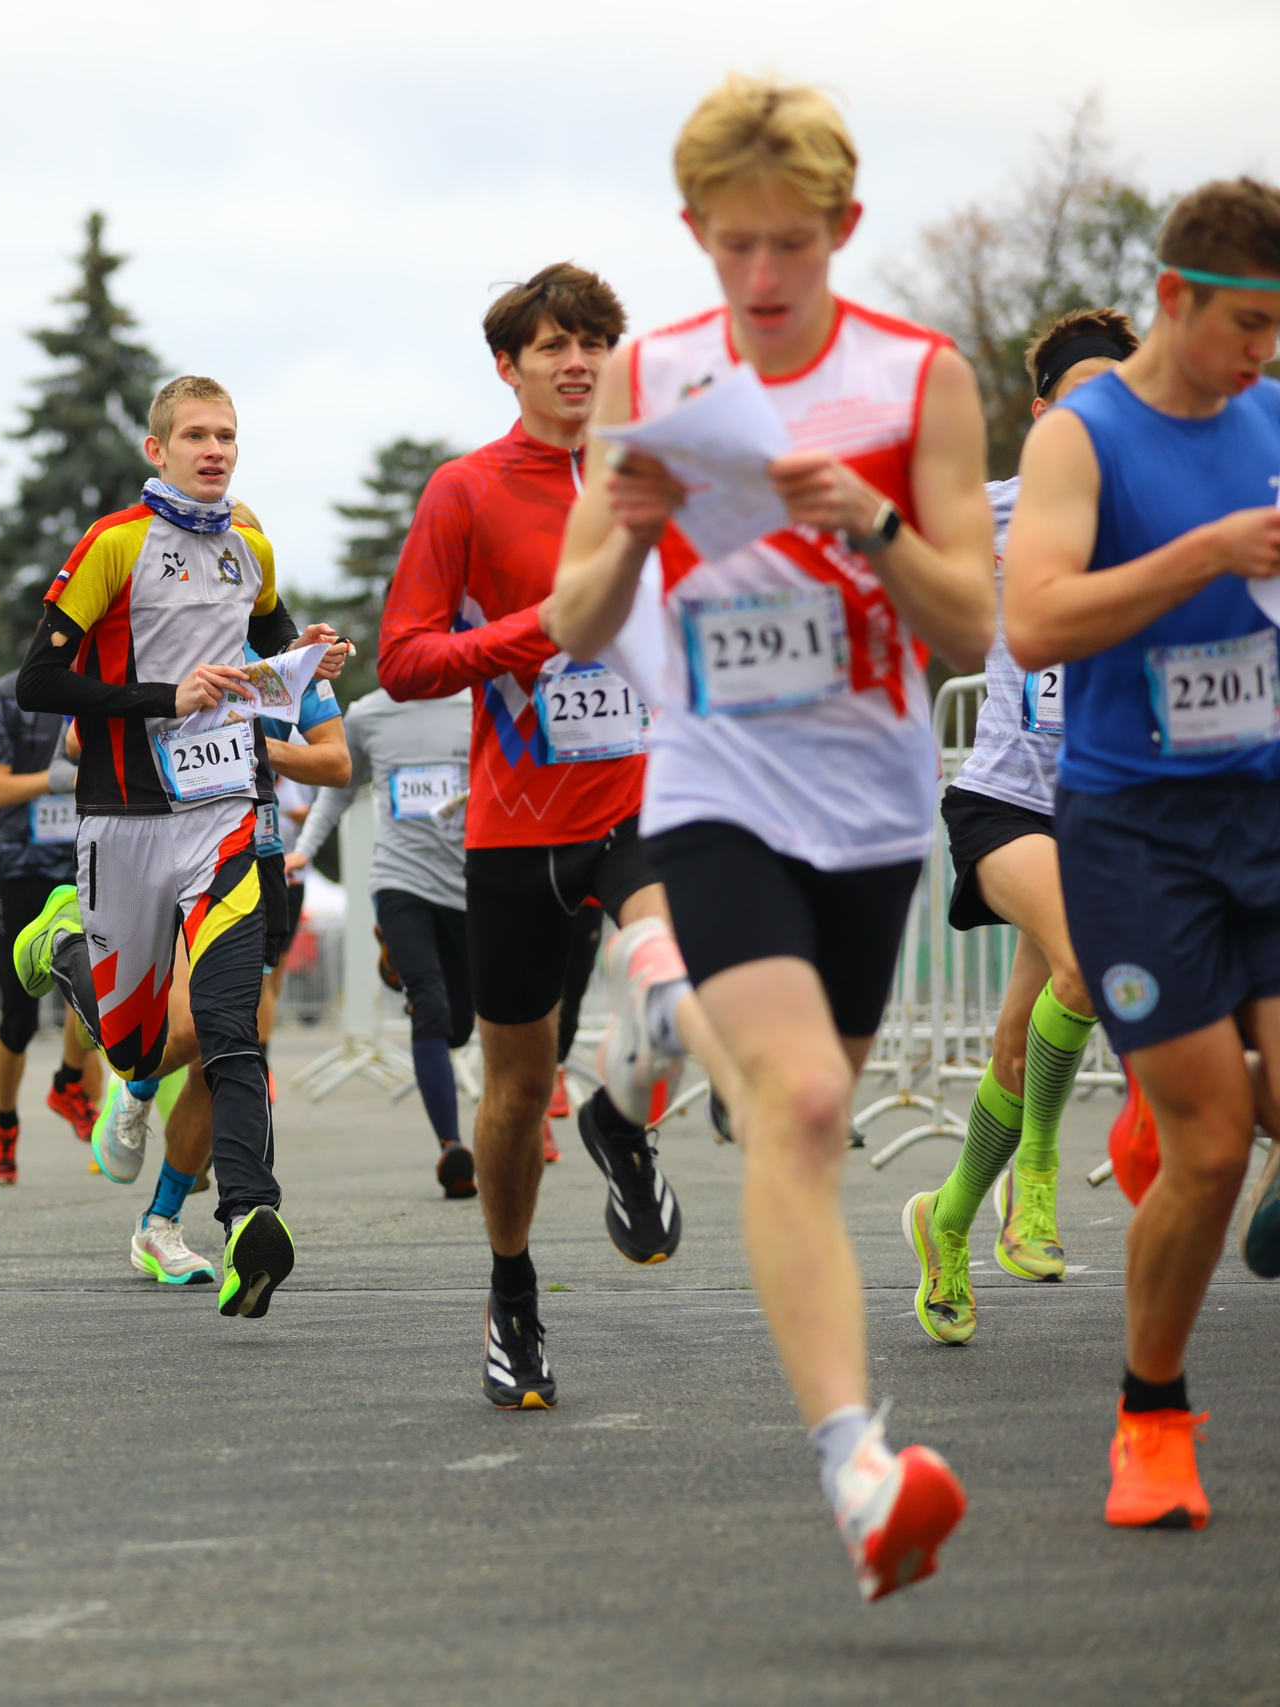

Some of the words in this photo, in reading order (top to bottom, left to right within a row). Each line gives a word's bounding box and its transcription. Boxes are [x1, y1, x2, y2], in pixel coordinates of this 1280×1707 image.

[709, 618, 821, 670] 229.1
[550, 686, 631, 722] 232.1
[1171, 663, 1265, 710] 220.1
[173, 737, 243, 773] 230.1
[400, 779, 448, 799] 208.1
